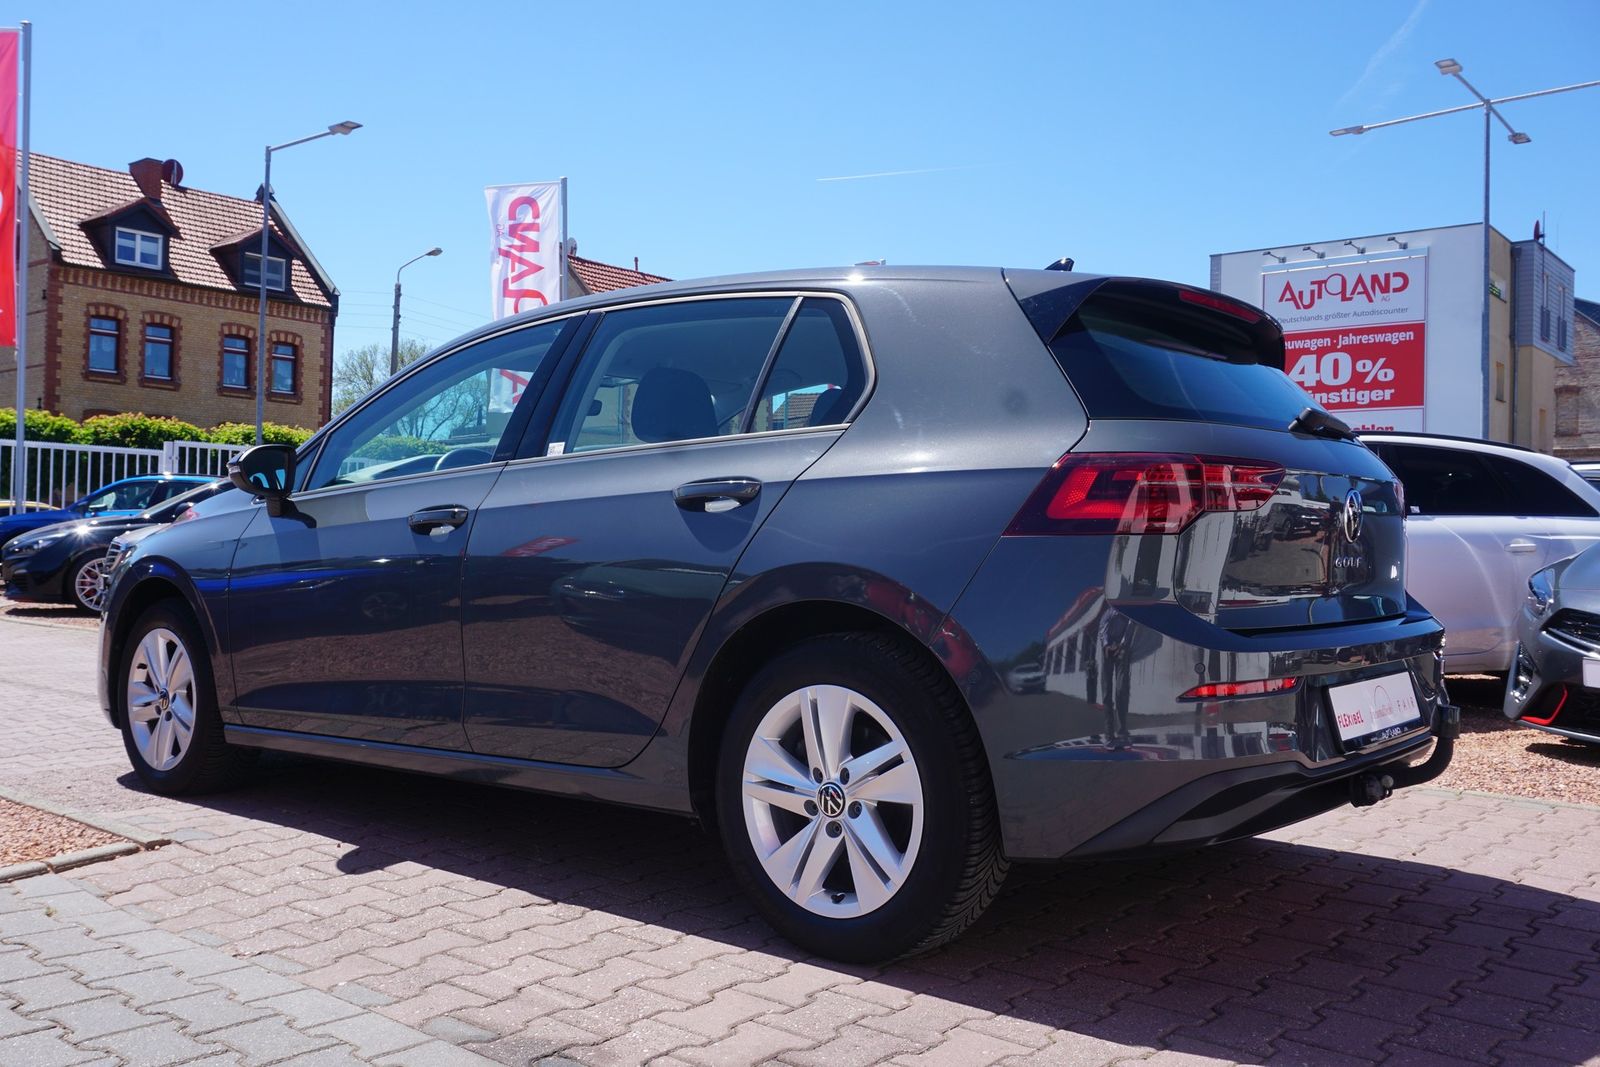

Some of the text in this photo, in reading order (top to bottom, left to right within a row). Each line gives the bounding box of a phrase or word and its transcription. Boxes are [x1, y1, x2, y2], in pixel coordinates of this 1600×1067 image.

[1278, 271, 1409, 310] AUTOLAND
[1352, 307, 1408, 318] Autodiscounter
[1337, 331, 1414, 348] Jahreswagen
[1288, 351, 1352, 387] 40
[1335, 557, 1362, 568] GOLF
[1337, 710, 1364, 728] FLEXIBEL
